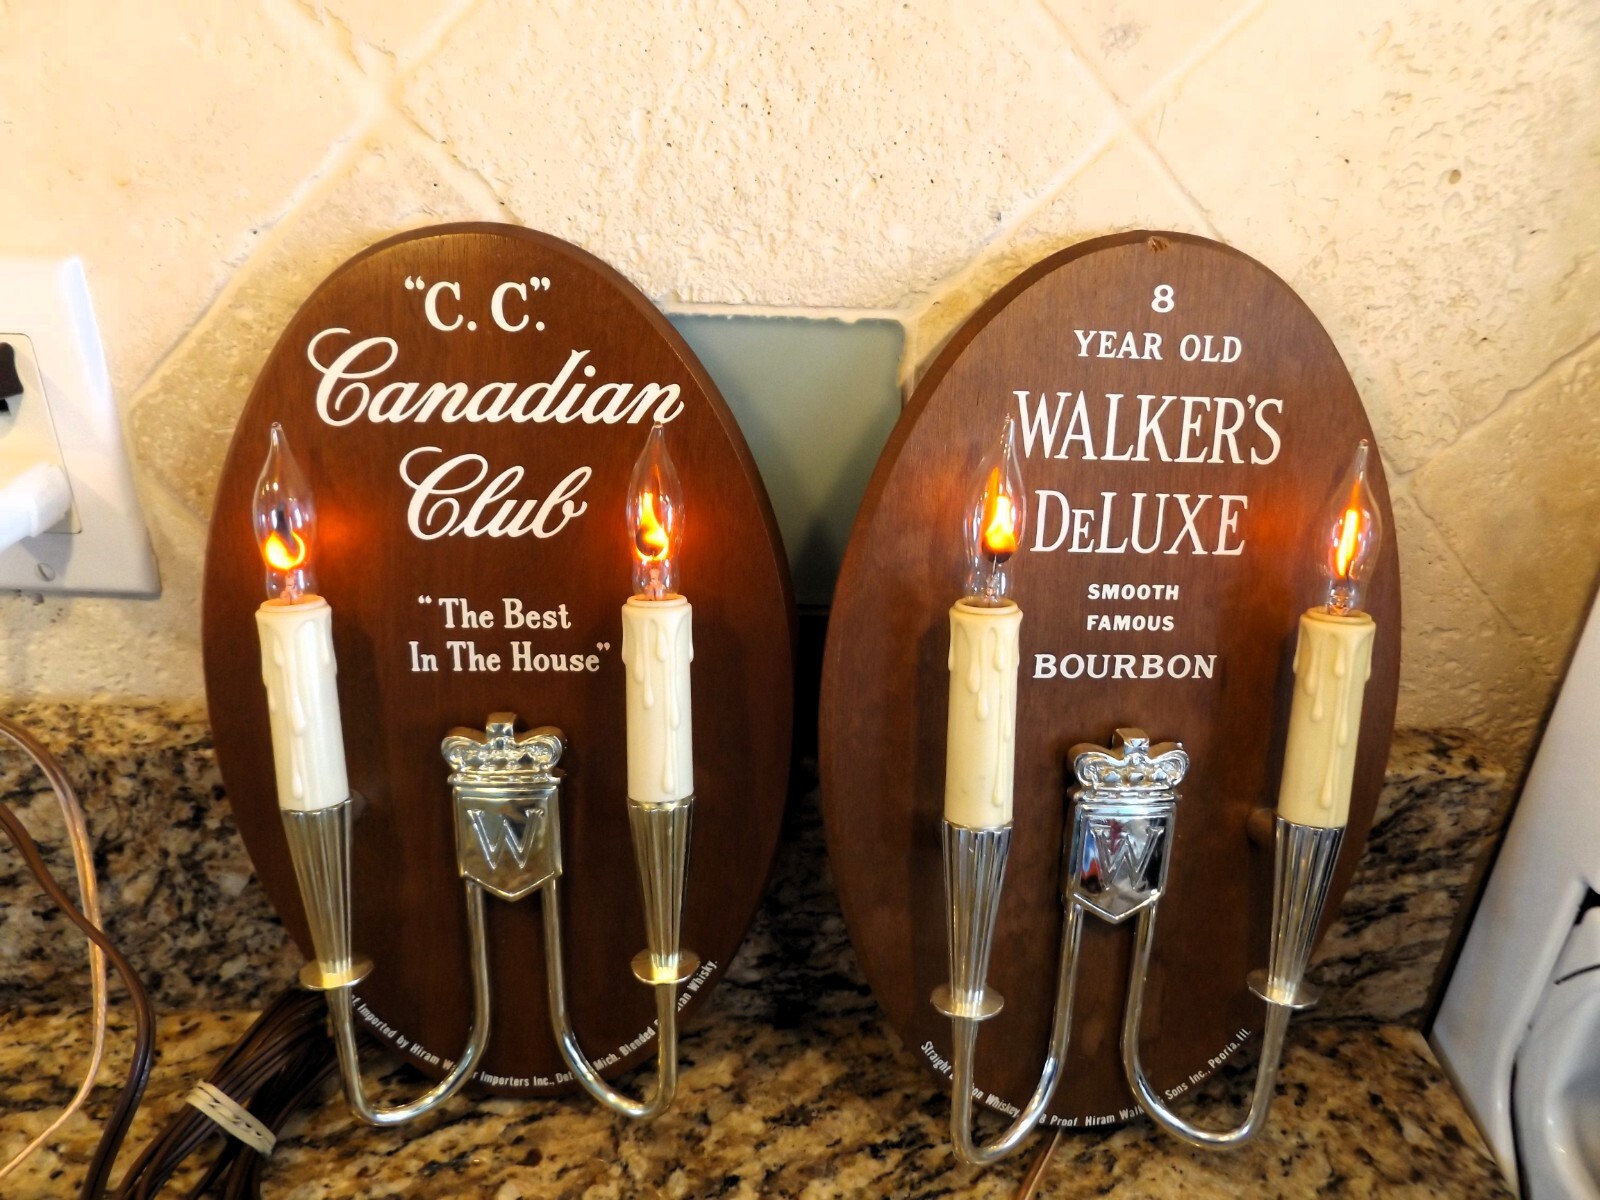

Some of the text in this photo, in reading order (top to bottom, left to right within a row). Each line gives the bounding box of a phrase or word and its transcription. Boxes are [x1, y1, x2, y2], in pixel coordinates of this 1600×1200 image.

[1150, 284, 1176, 315] 8
[1073, 329, 1243, 363] YEAR OLD
[307, 327, 685, 427] Canadian
[1011, 390, 1284, 467] WALKER'S
[398, 446, 593, 541] Club
[502, 598, 572, 630] Best
[1087, 583, 1180, 601] SMOOTH
[1086, 614, 1175, 632] FAMOUS
[408, 641, 438, 672] In
[446, 640, 501, 672] The
[1032, 653, 1218, 680] BOURBON
[467, 808, 545, 870] W
[1088, 826, 1165, 890] W
[356, 1003, 398, 1039] Imported
[396, 1034, 410, 1050] by
[409, 1043, 441, 1066] Hiram
[480, 1070, 530, 1087] Importers
[592, 1053, 622, 1072] Mich.
[618, 1025, 657, 1057] Blended
[686, 960, 719, 992] Whisky.
[920, 1040, 953, 1075] Straight
[1049, 1113, 1079, 1128] Proof
[1085, 1114, 1116, 1128] Hiram
[1164, 1081, 1190, 1101] Sons
[1235, 1028, 1253, 1043] Ill.
